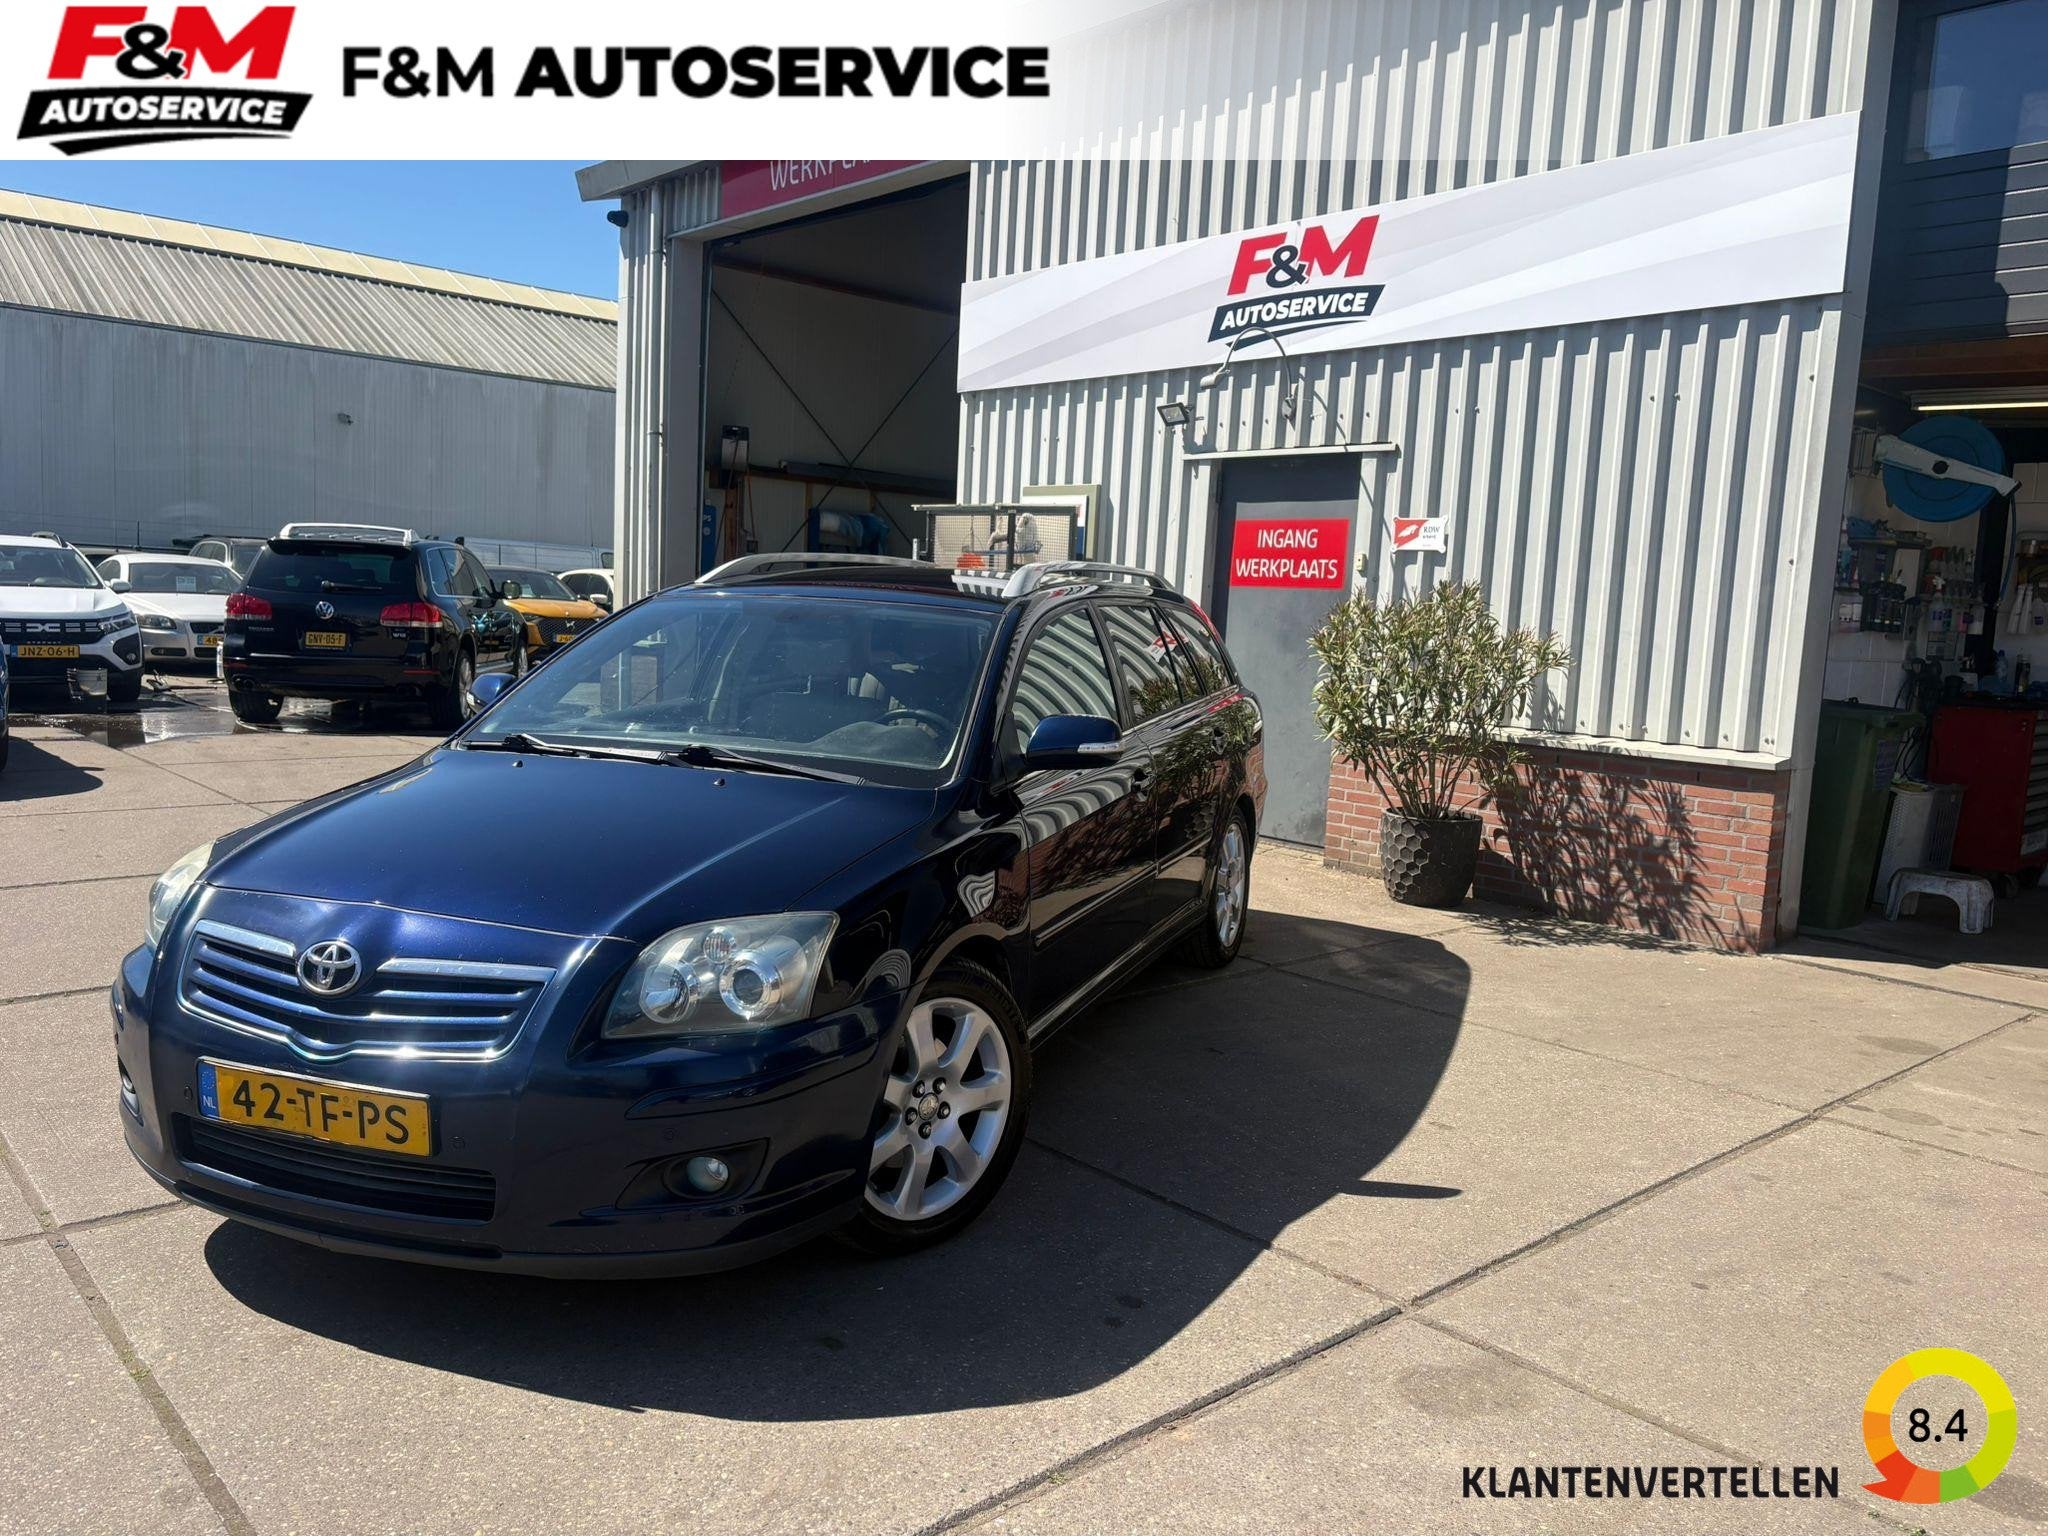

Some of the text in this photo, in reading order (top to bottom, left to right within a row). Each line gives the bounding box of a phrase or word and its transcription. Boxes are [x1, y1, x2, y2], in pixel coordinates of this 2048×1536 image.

[1227, 214, 1380, 296] F&M
[1220, 292, 1369, 331] AUTOSERVICE
[1257, 529, 1318, 549] INGANG
[1235, 558, 1338, 579] WERKPLAATS
[20, 646, 75, 657] JNZ-06-H
[202, 1096, 216, 1109] NL
[232, 1079, 409, 1145] 42-TF-PS
